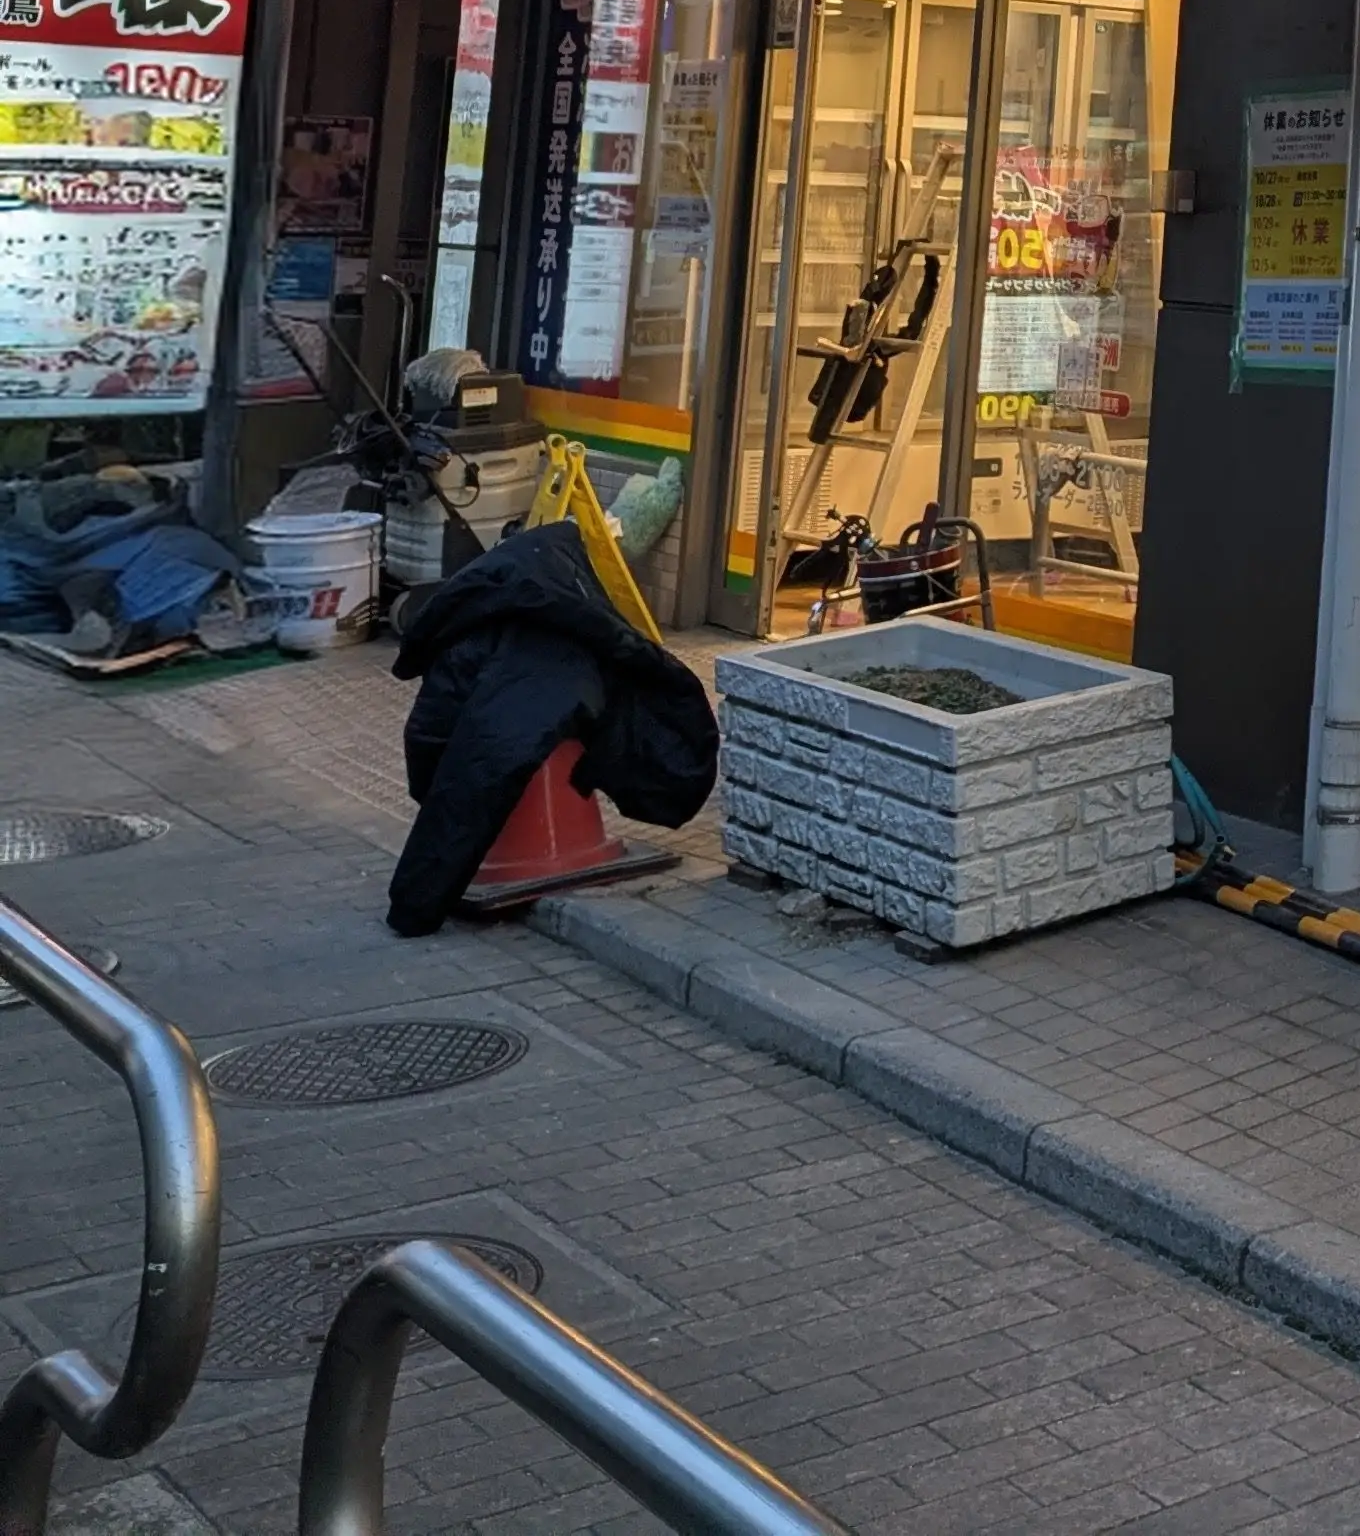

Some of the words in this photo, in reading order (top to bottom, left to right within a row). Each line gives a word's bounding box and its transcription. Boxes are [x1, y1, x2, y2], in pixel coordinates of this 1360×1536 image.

[529, 31, 579, 372] 全国発送承り中
[1291, 216, 1331, 245] 休業
